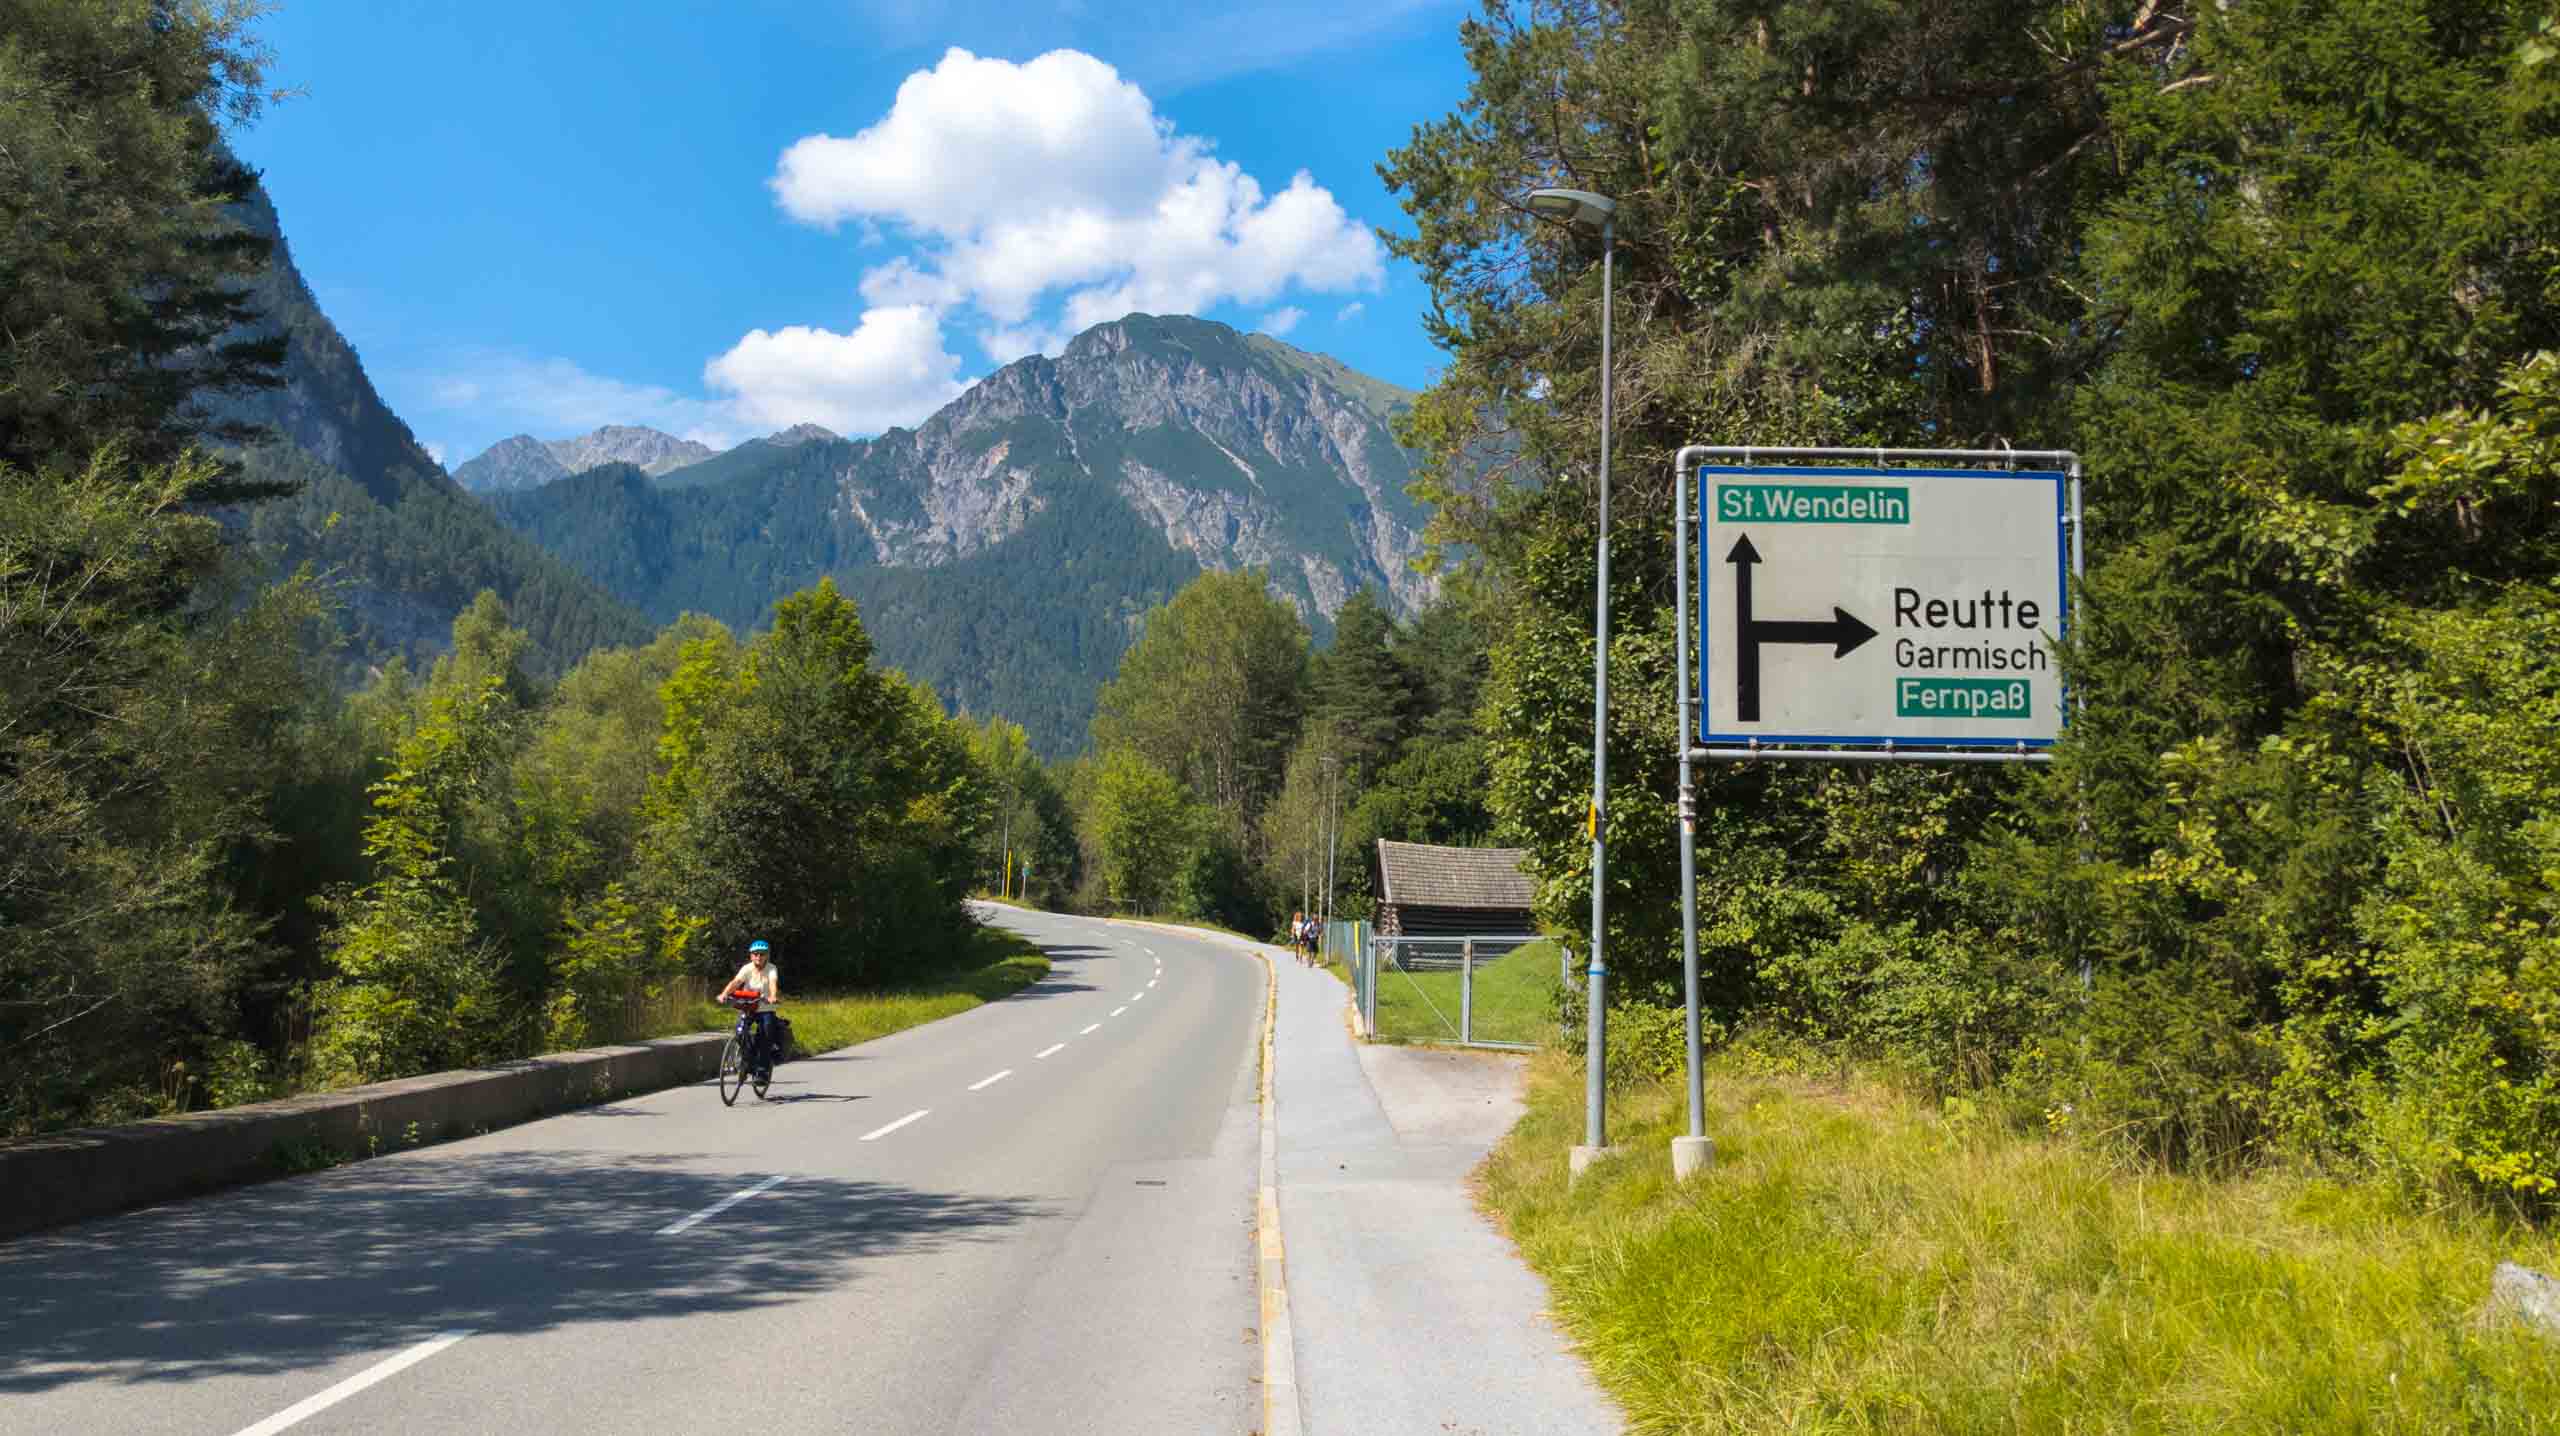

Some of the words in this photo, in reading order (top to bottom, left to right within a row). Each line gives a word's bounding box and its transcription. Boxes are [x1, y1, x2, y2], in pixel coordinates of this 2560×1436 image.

[1894, 587, 2041, 630] Reutte
[1895, 638, 2047, 671] Garmisch
[1901, 682, 2025, 717] Fernpaß
